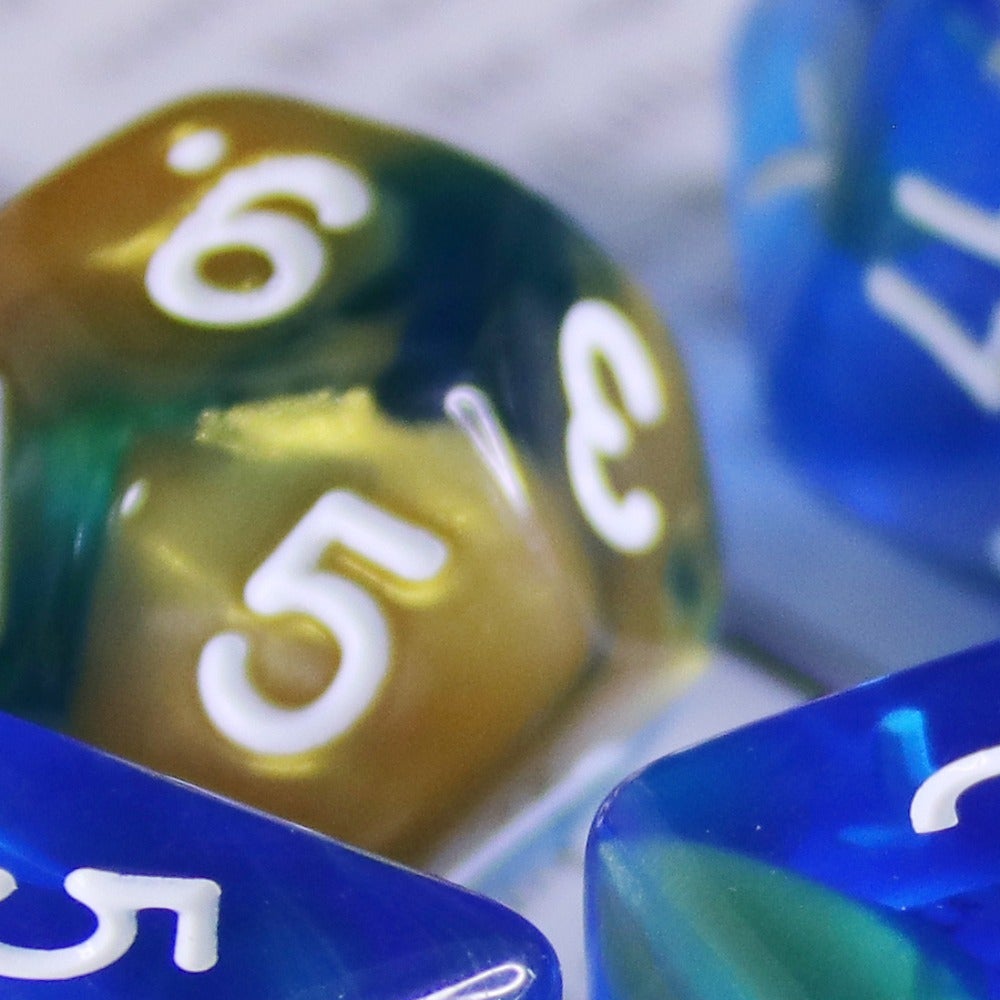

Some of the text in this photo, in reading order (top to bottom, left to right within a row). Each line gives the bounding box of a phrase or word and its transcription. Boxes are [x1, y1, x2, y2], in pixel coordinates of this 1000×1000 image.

[556, 298, 665, 555] 3
[198, 488, 451, 757] 5
[0, 867, 222, 981] 5
